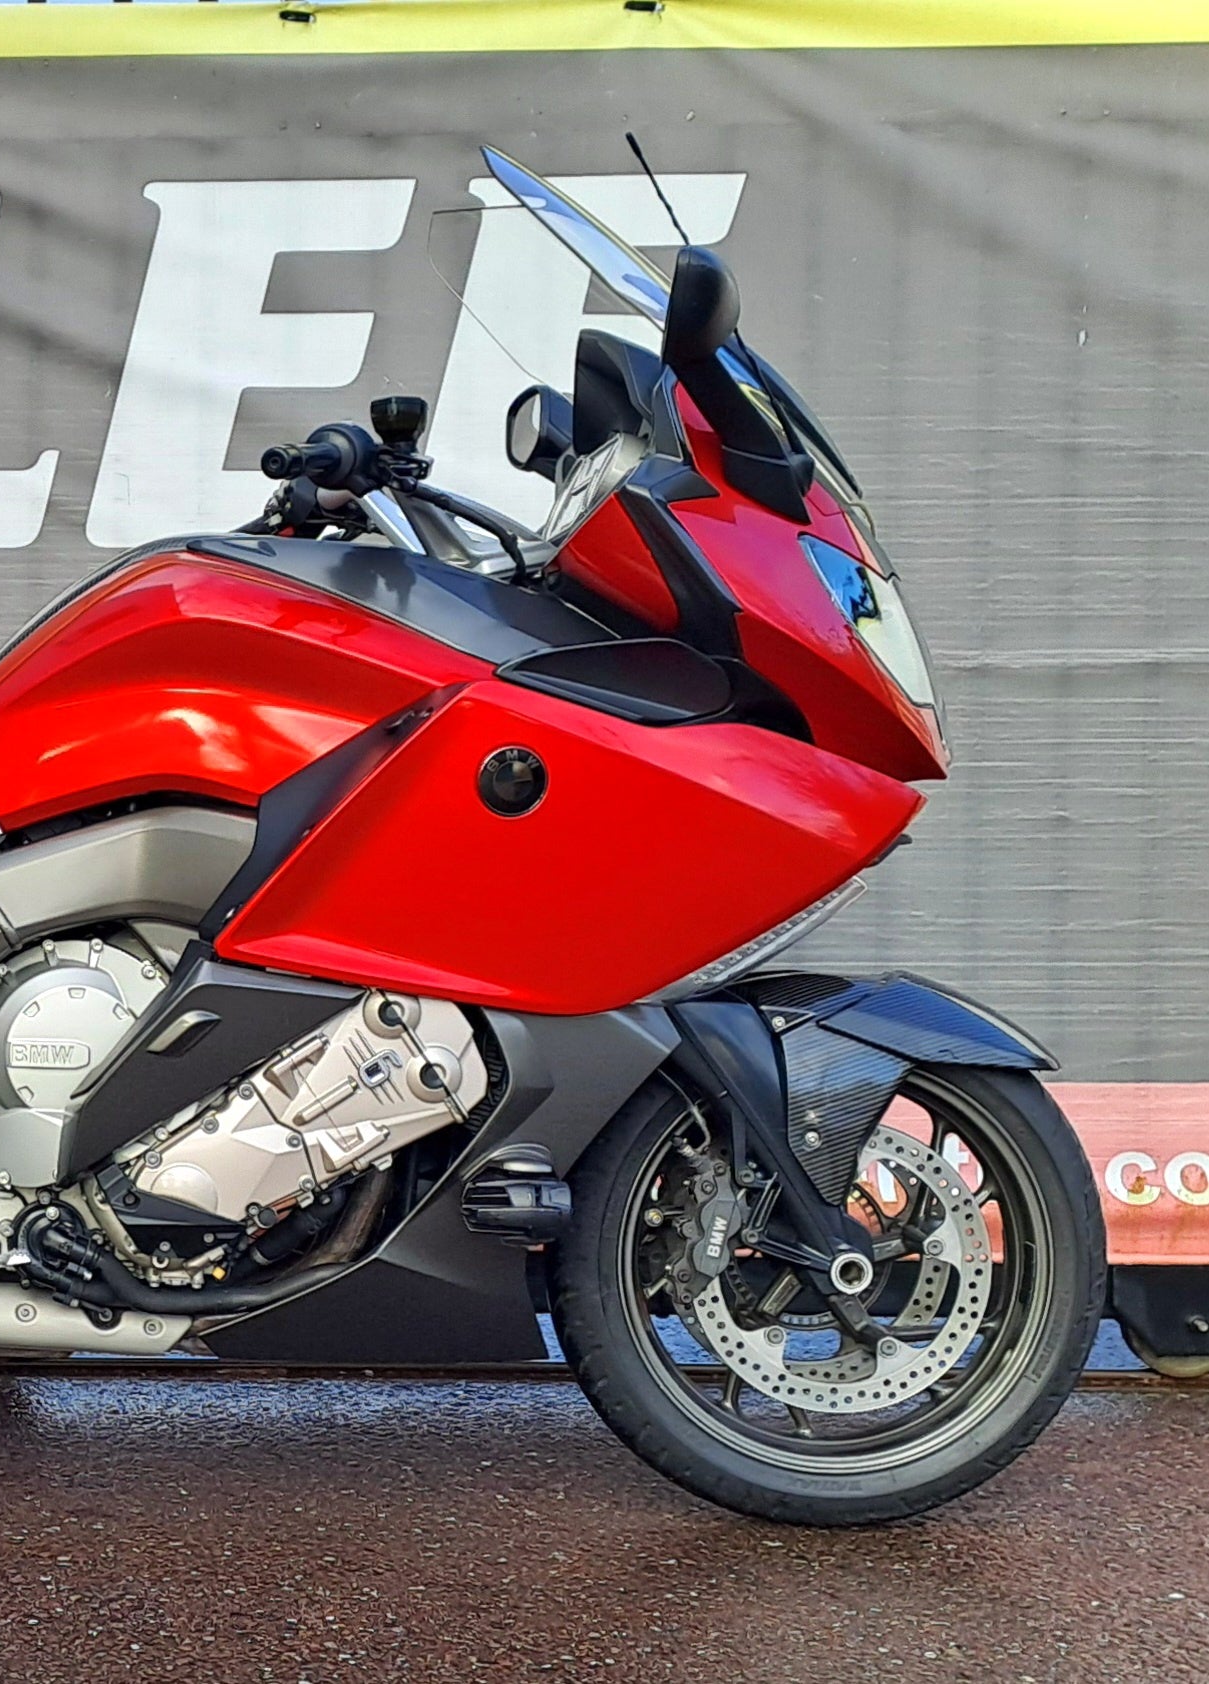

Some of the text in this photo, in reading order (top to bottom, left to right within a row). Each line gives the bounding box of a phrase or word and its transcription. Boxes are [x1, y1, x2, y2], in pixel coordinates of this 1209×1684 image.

[486, 749, 540, 773] BMW
[11, 1043, 76, 1065] BMW
[706, 1215, 728, 1258] BMW
